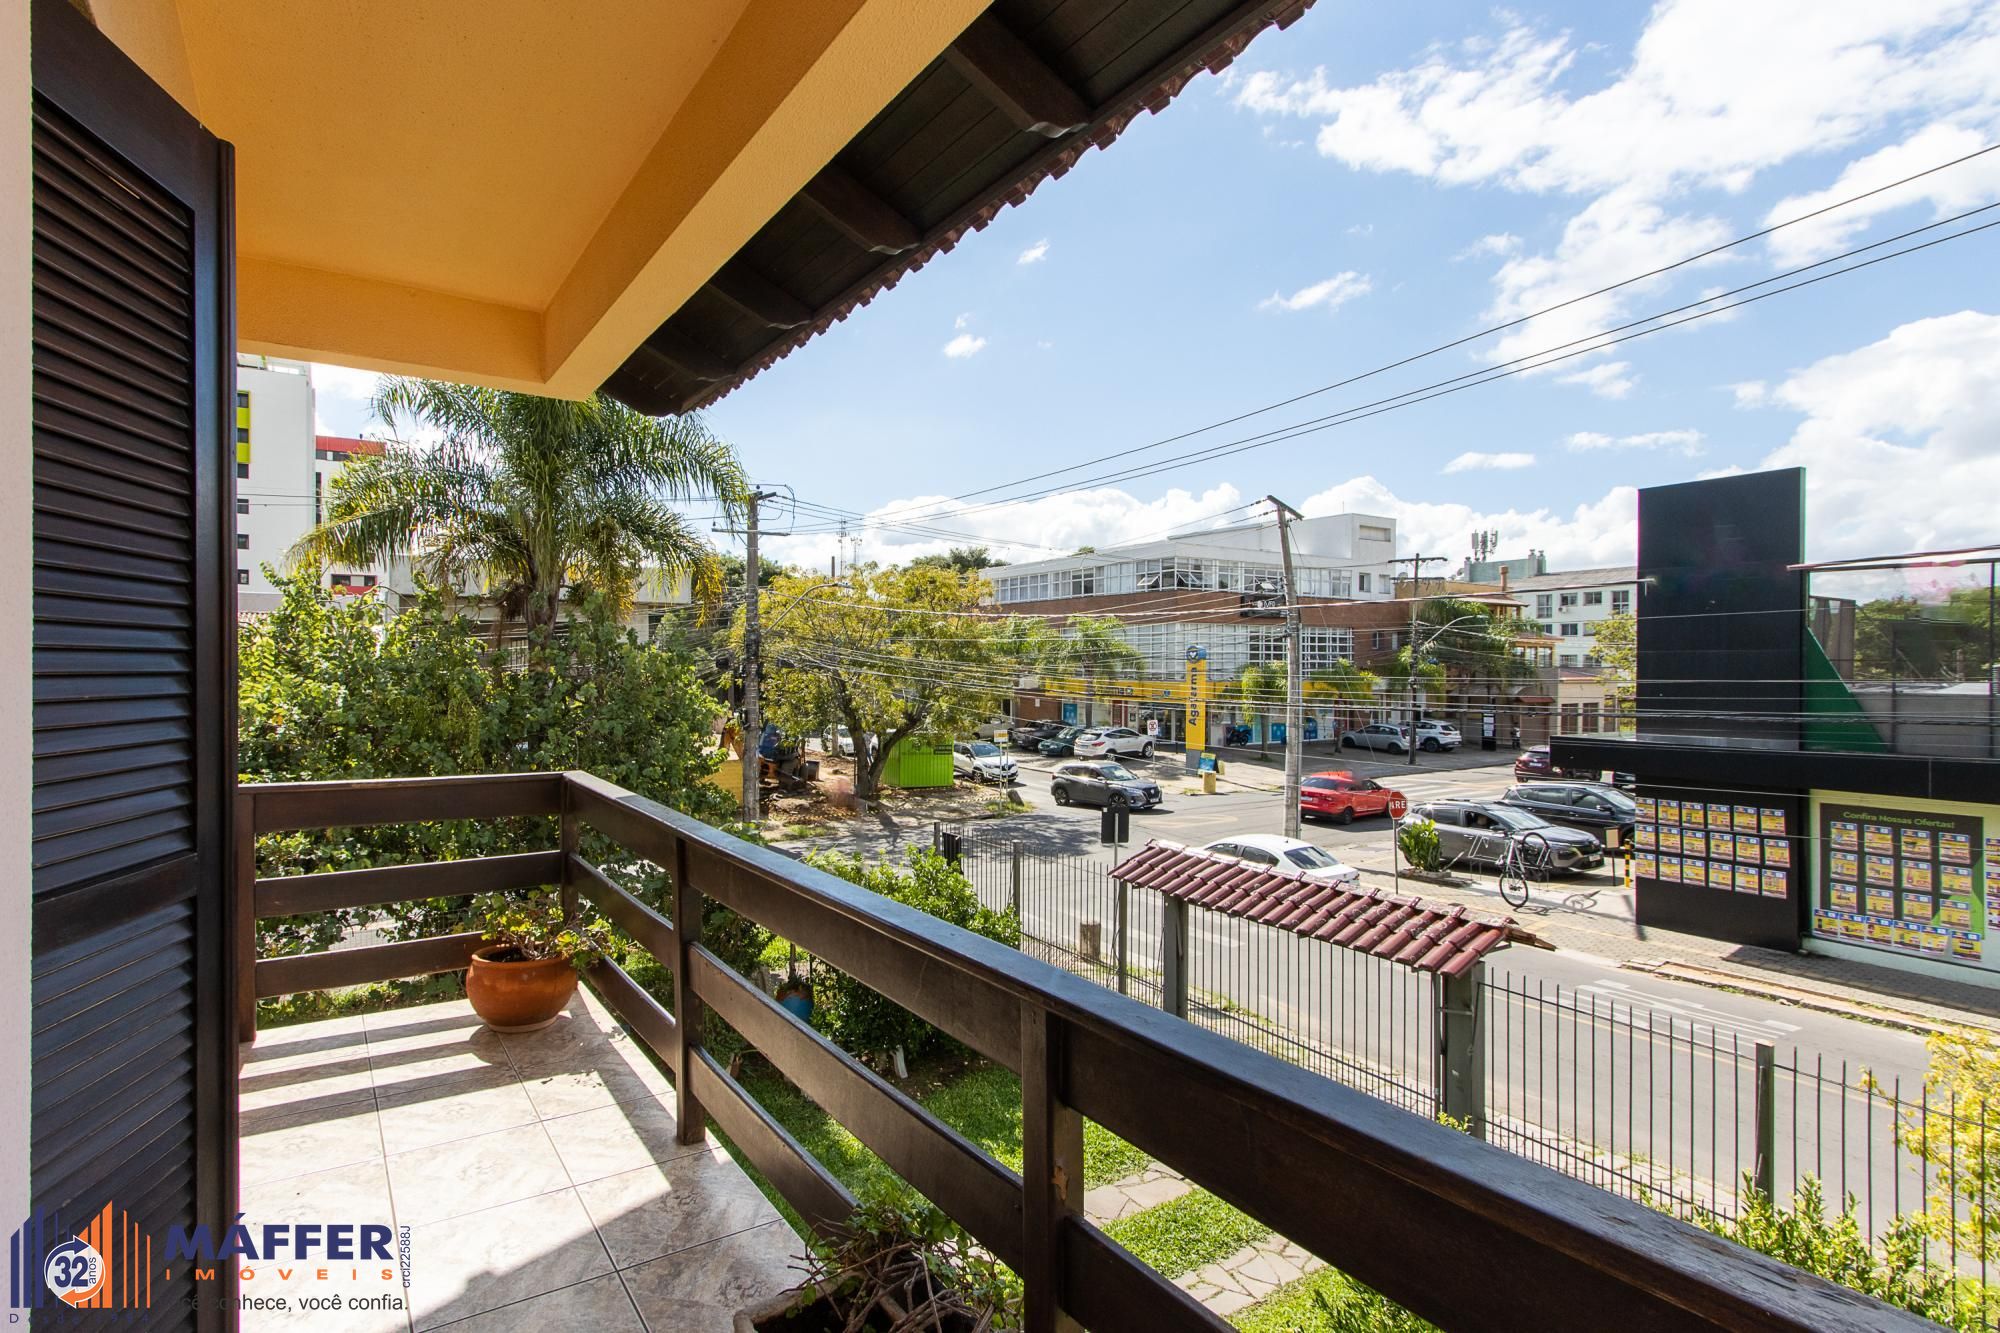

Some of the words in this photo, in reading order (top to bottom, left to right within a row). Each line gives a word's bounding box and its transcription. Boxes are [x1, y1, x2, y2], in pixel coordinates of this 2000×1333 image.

[1843, 811, 1878, 821] Confira
[1879, 815, 1912, 825] Nossas
[1914, 818, 1955, 828] Ofertas!
